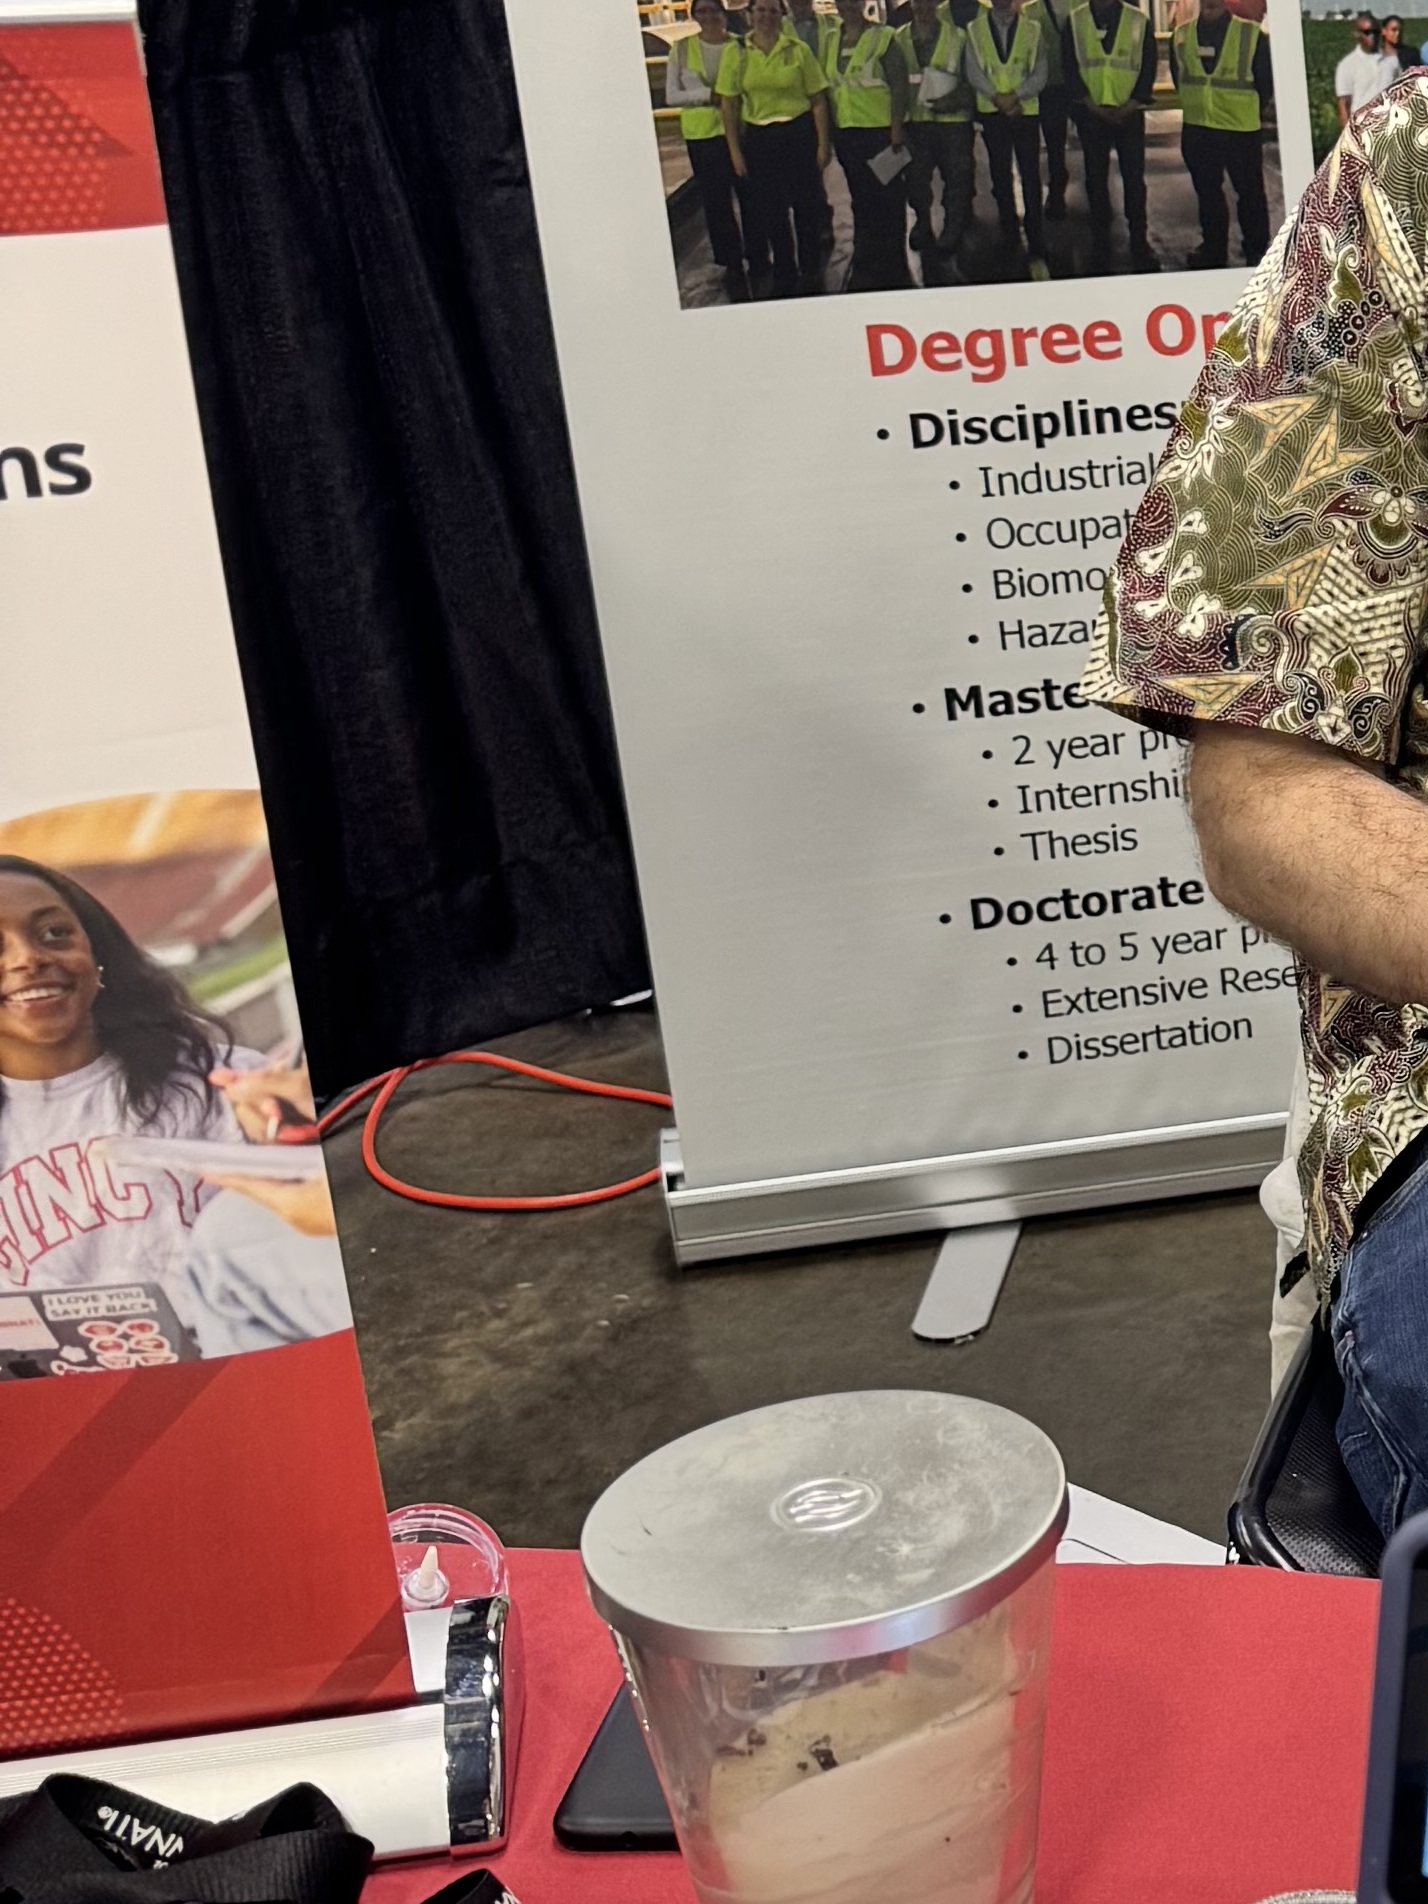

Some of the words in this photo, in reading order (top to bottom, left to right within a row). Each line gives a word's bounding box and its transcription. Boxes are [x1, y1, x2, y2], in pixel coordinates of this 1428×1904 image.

[866, 319, 1123, 384] Degree
[979, 455, 1154, 498] Industrial
[1012, 736, 1035, 765] 2
[1046, 734, 1126, 768] year
[1020, 824, 1138, 861] Thesis
[970, 877, 1205, 930] Doctorate
[1036, 942, 1058, 970] 4
[1067, 941, 1106, 966] to
[1119, 932, 1139, 961] 5
[1151, 927, 1227, 964] year
[1042, 973, 1208, 1017] Extensive
[1048, 1015, 1253, 1065] Dissertation
